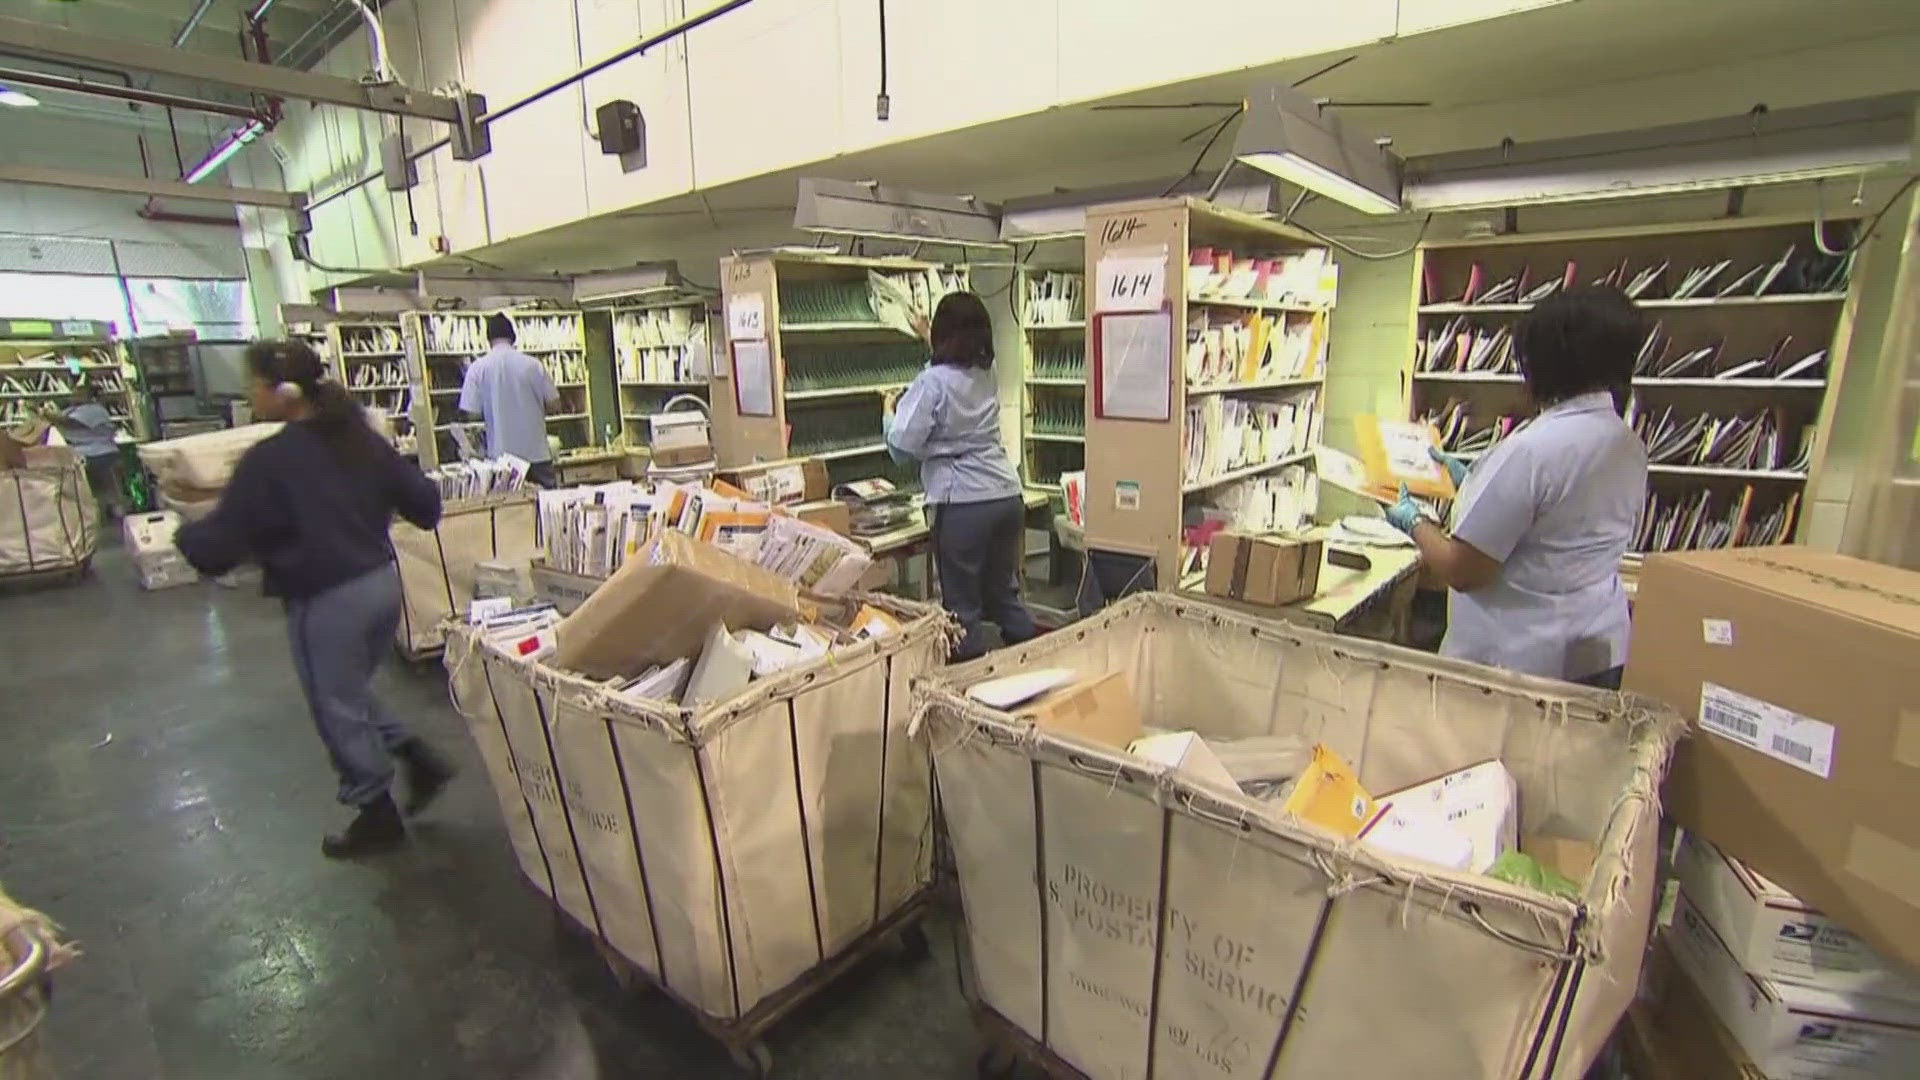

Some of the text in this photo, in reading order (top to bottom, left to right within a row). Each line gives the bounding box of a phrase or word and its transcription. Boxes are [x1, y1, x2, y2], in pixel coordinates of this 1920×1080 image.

[1100, 217, 1147, 246] 1614
[1111, 273, 1152, 298] 1614
[1074, 899, 1169, 959] POSTA
[1213, 932, 1254, 969] OF
